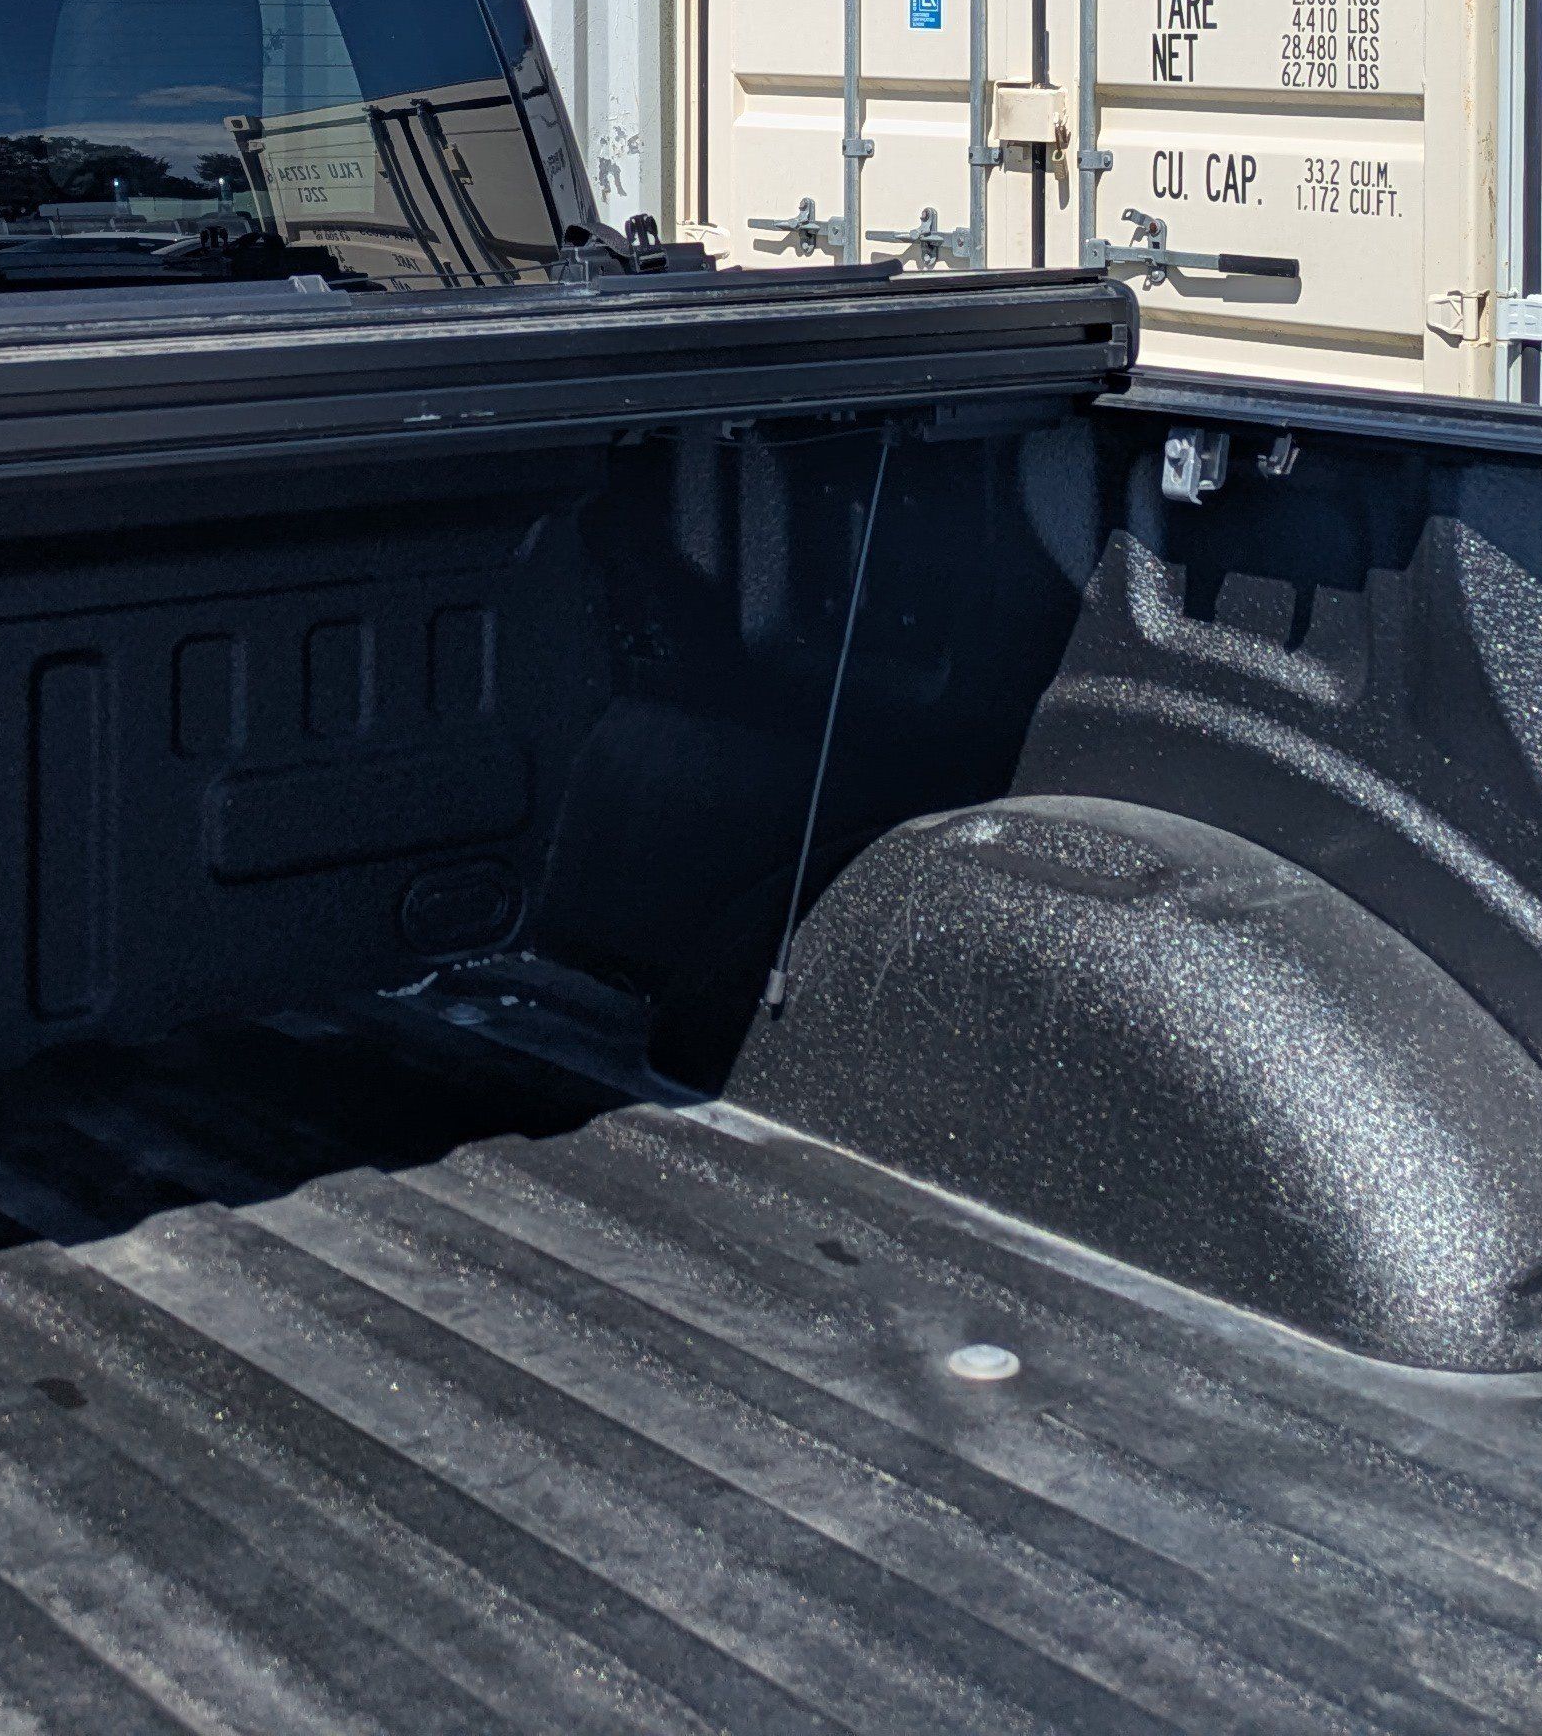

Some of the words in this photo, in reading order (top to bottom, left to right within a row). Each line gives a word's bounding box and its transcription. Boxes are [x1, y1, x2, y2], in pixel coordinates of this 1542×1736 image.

[1293, 7, 1337, 33] 4,410
[1348, 8, 1379, 34] LBS
[1152, 34, 1198, 82] NET
[1282, 34, 1337, 60] 28,480
[1348, 35, 1379, 61] KGS
[1282, 61, 1337, 88] 62,790
[1348, 63, 1379, 90] LBS
[1153, 151, 1188, 200] CU.
[1206, 153, 1262, 205] CAP.
[1305, 158, 1340, 185] 33.2
[1351, 161, 1392, 188] CU.M.
[1350, 188, 1402, 217] CU.FT.
